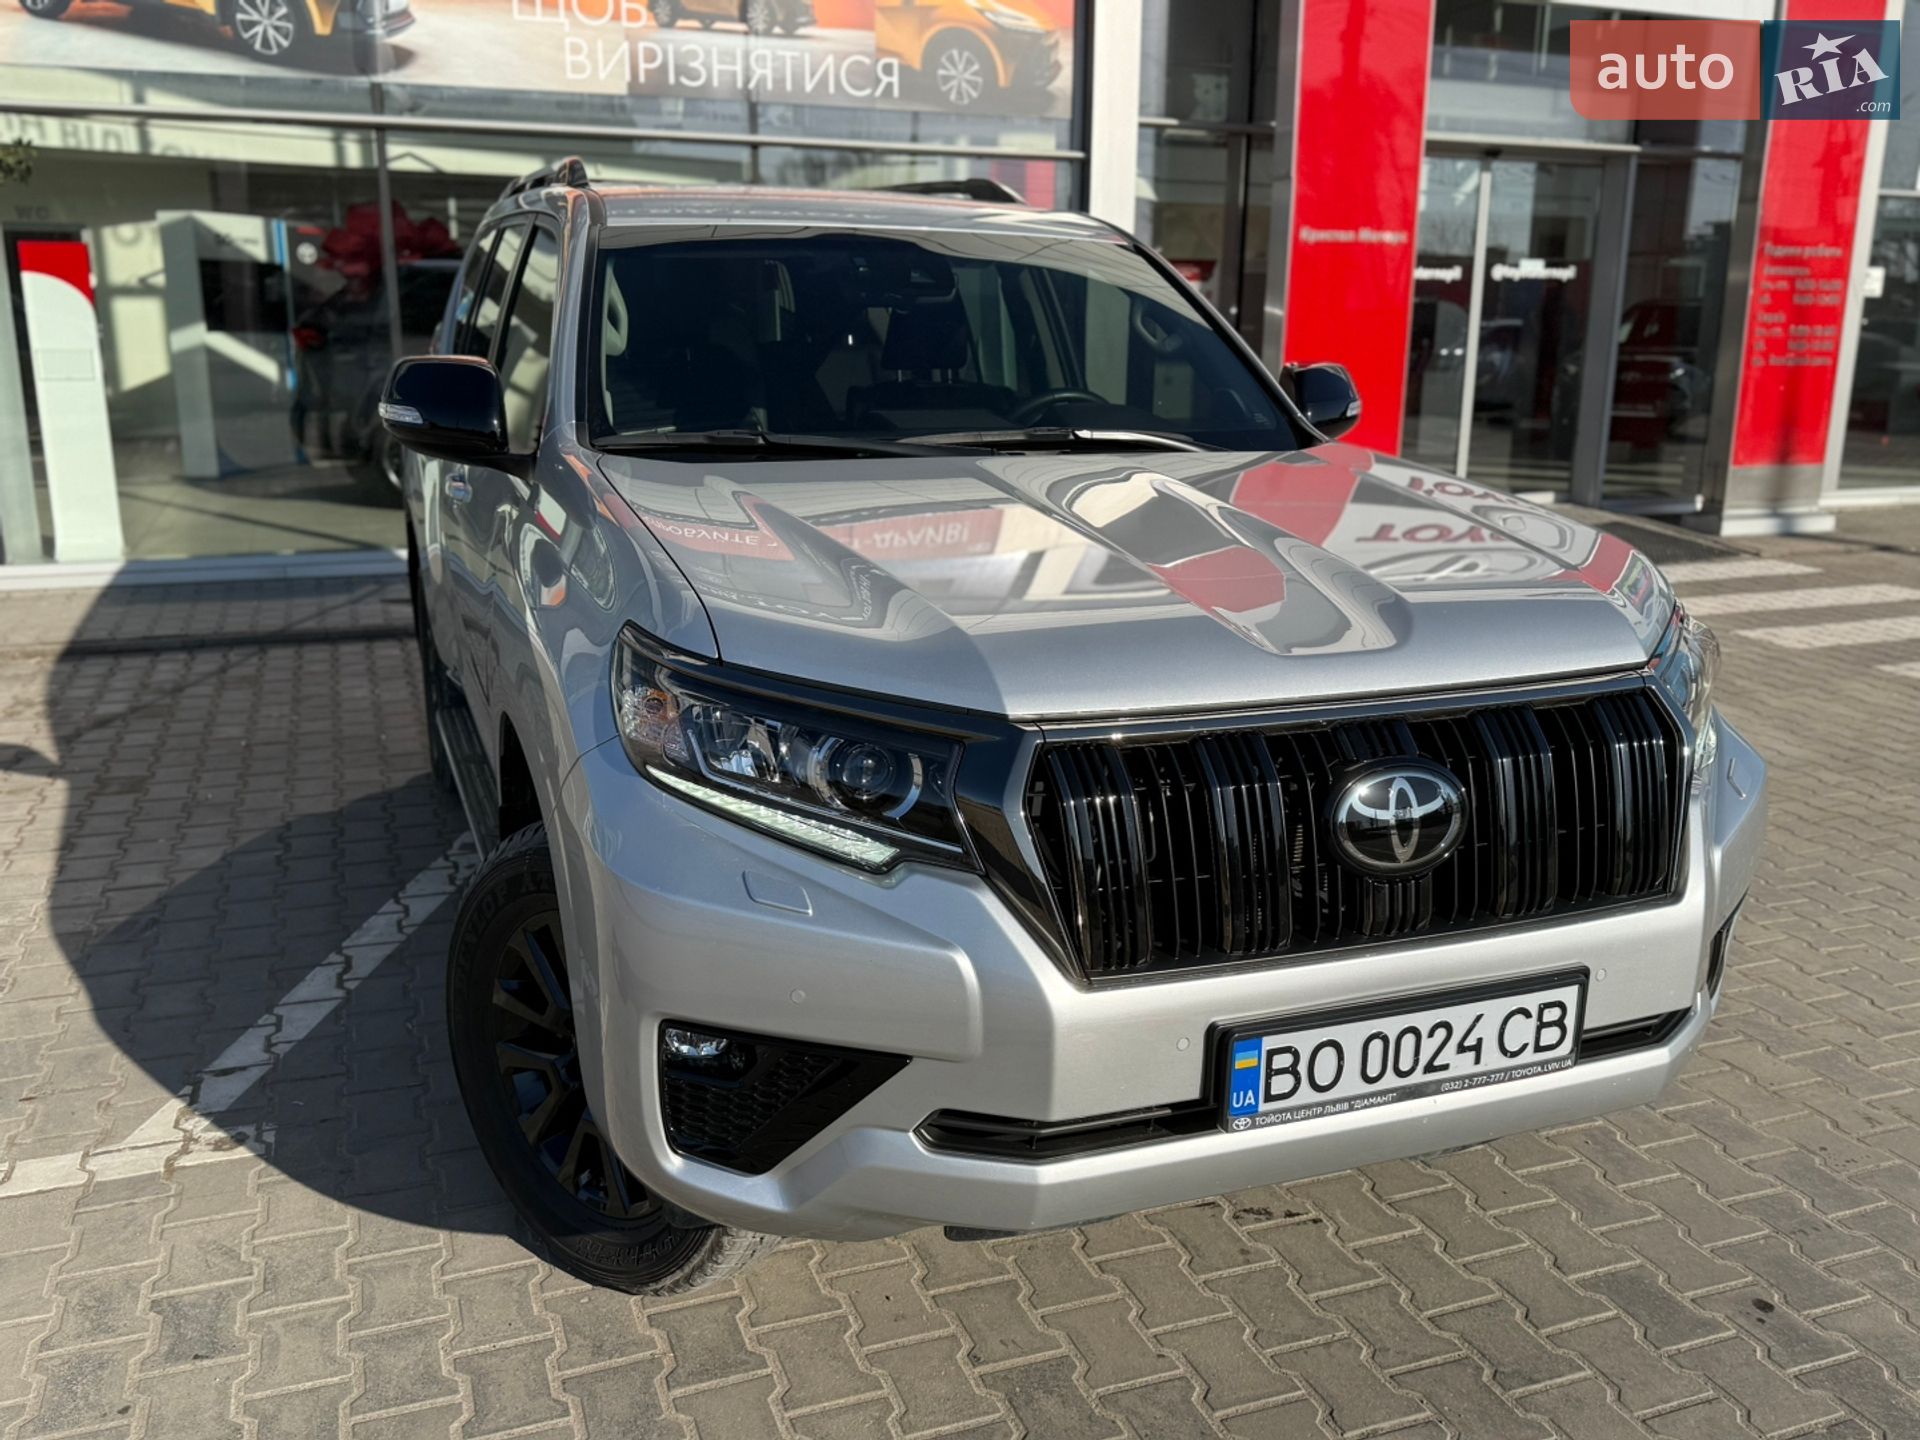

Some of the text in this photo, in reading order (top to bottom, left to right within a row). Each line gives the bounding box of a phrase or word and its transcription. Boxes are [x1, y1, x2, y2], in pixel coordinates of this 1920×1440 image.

[512, 0, 648, 31] ЩОБ
[564, 37, 901, 98] ВИРІЗНЯТИСЯ
[1264, 1000, 1568, 1103] BO 0024 CB
[1441, 1080, 1463, 1092] (032)
[1463, 1071, 1505, 1088] 2-777-777
[1511, 1058, 1573, 1079] TOYOTA.LVIV.UA
[1231, 1088, 1256, 1108] UA
[1255, 1092, 1398, 1126] ТОЙОТА ЦЕНТР ЛЬВІВ "ДІАМАНТ"
